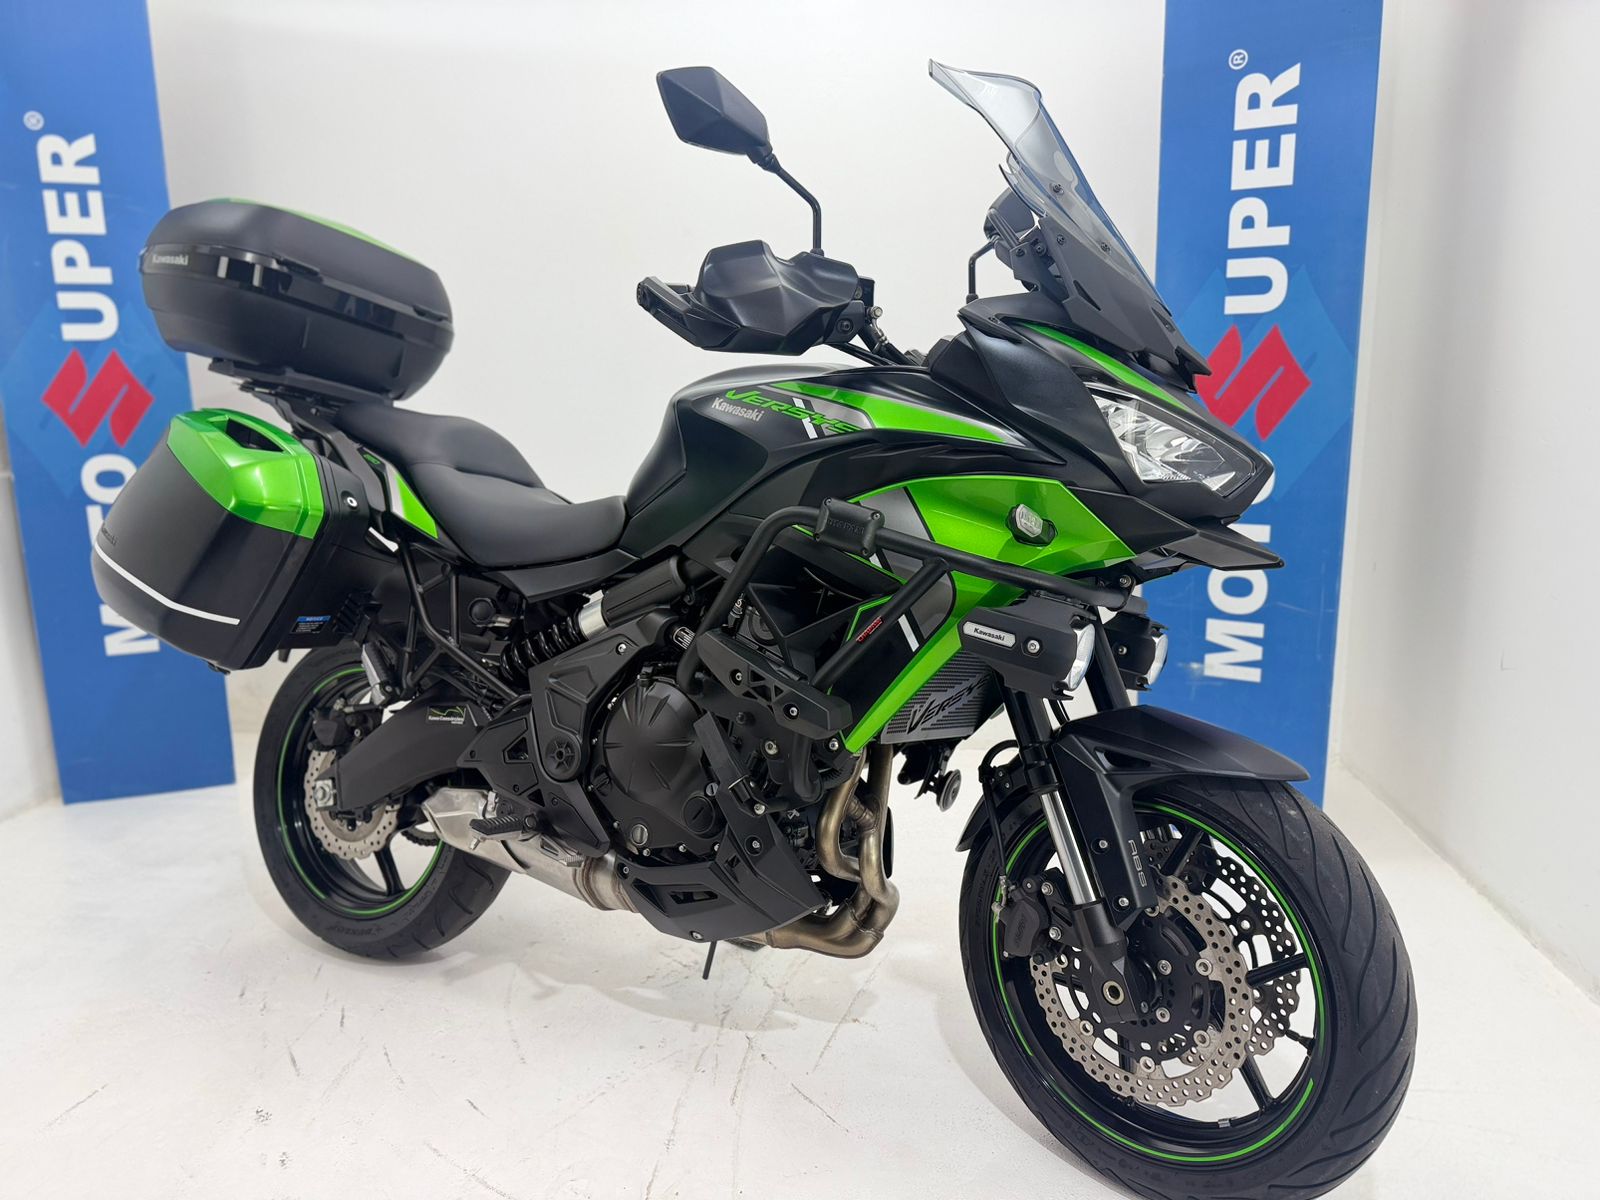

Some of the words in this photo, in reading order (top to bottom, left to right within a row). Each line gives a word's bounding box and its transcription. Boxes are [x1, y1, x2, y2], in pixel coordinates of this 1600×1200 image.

[711, 397, 765, 422] Kawasaki
[973, 627, 1006, 642] Kawasaki
[1128, 839, 1148, 888] ABS
